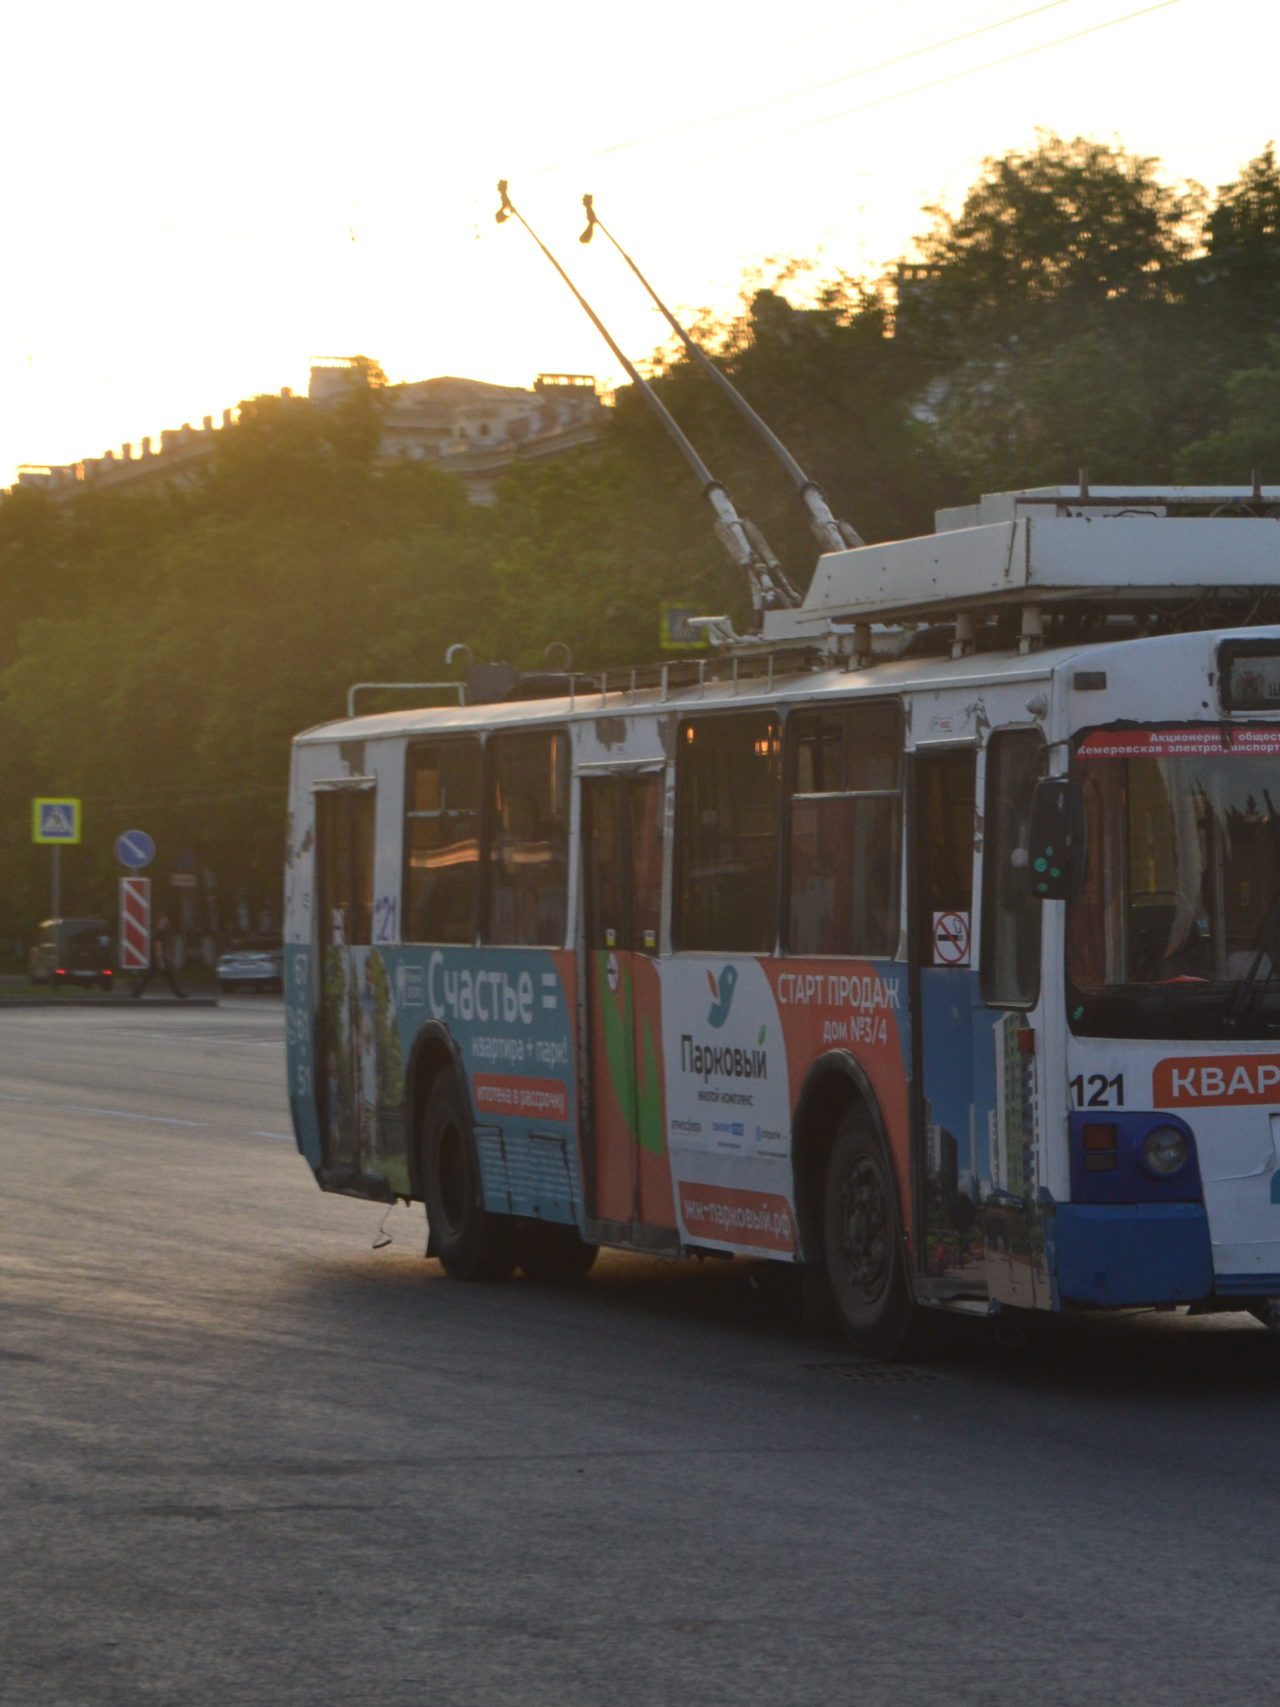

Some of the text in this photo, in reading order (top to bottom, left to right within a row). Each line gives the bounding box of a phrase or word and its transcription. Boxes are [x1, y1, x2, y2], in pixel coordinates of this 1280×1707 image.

[1077, 744, 1162, 756] Кемеровская
[428, 950, 533, 1024] Счастье
[778, 973, 900, 1014] СТАРТ ПРОДАЖ
[472, 1036, 524, 1066] квартира
[824, 1021, 848, 1044] дом
[681, 1028, 767, 1085] Парковый
[1070, 1073, 1124, 1107] 121
[684, 1199, 792, 1242] жк-парковый.рф
